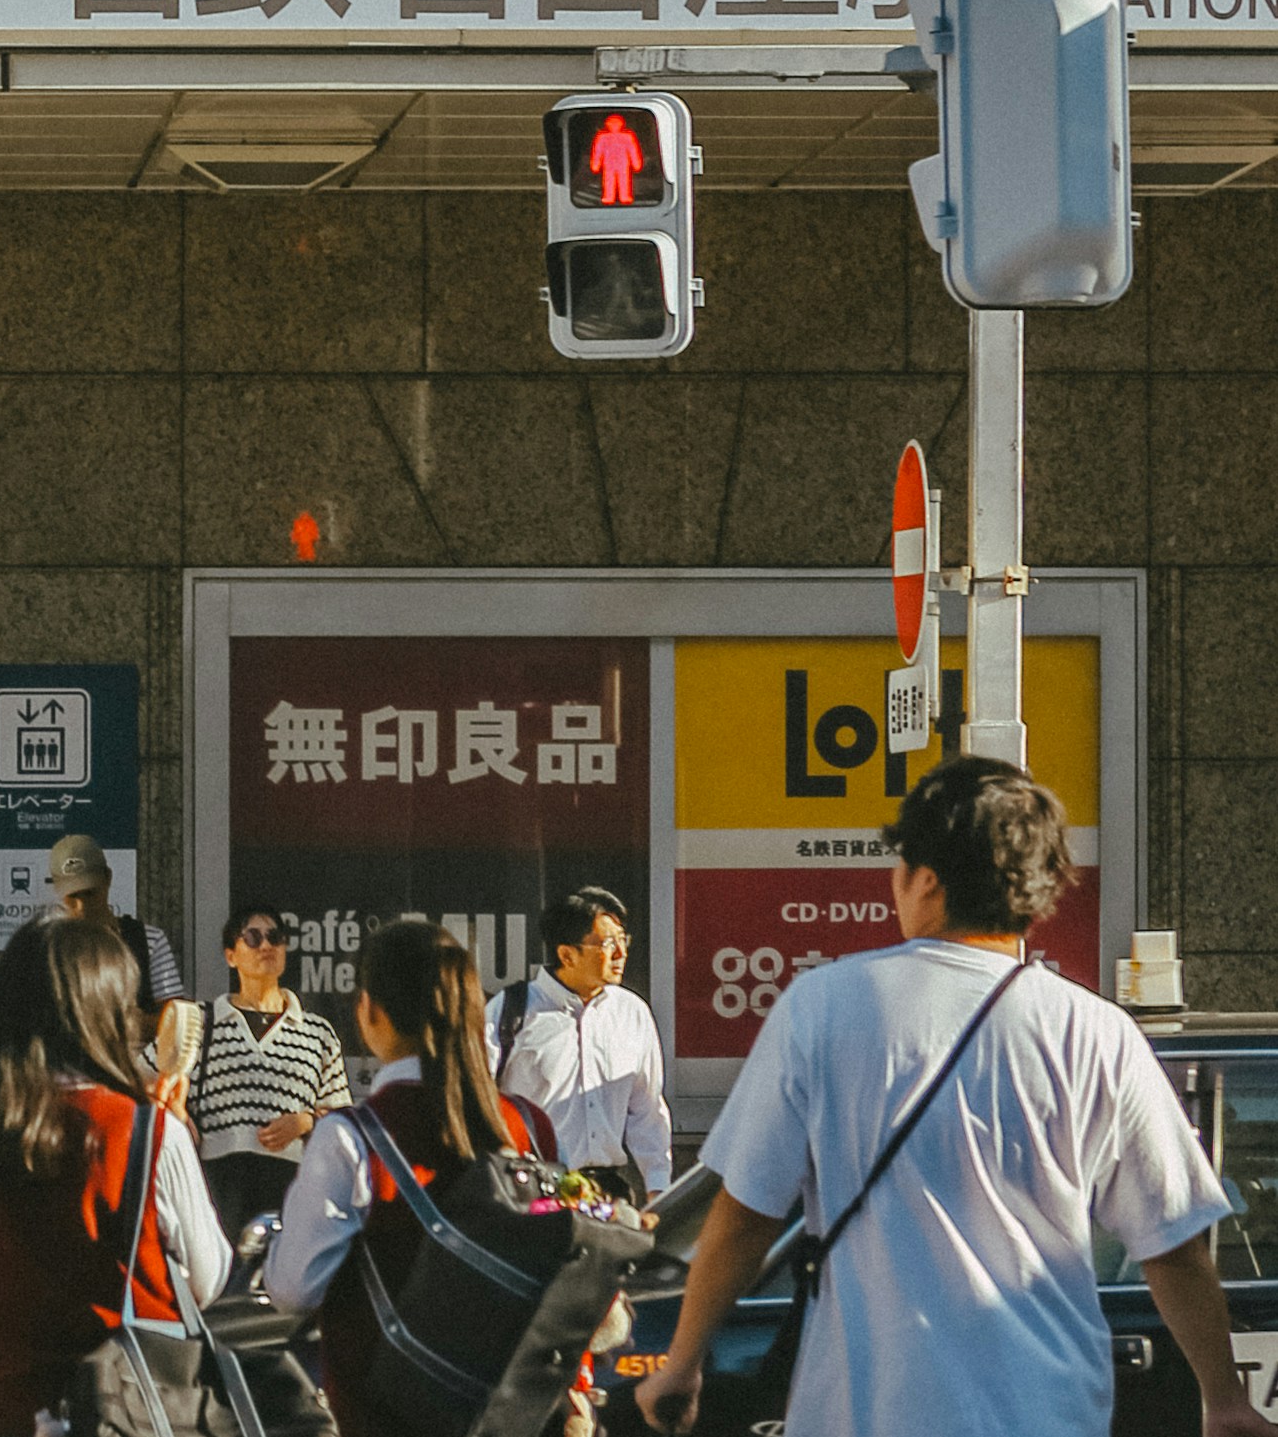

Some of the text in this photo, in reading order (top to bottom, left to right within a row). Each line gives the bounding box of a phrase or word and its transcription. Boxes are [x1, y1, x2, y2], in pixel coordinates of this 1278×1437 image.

[263, 700, 619, 785] 無印良品
[16, 812, 66, 823] Elevator
